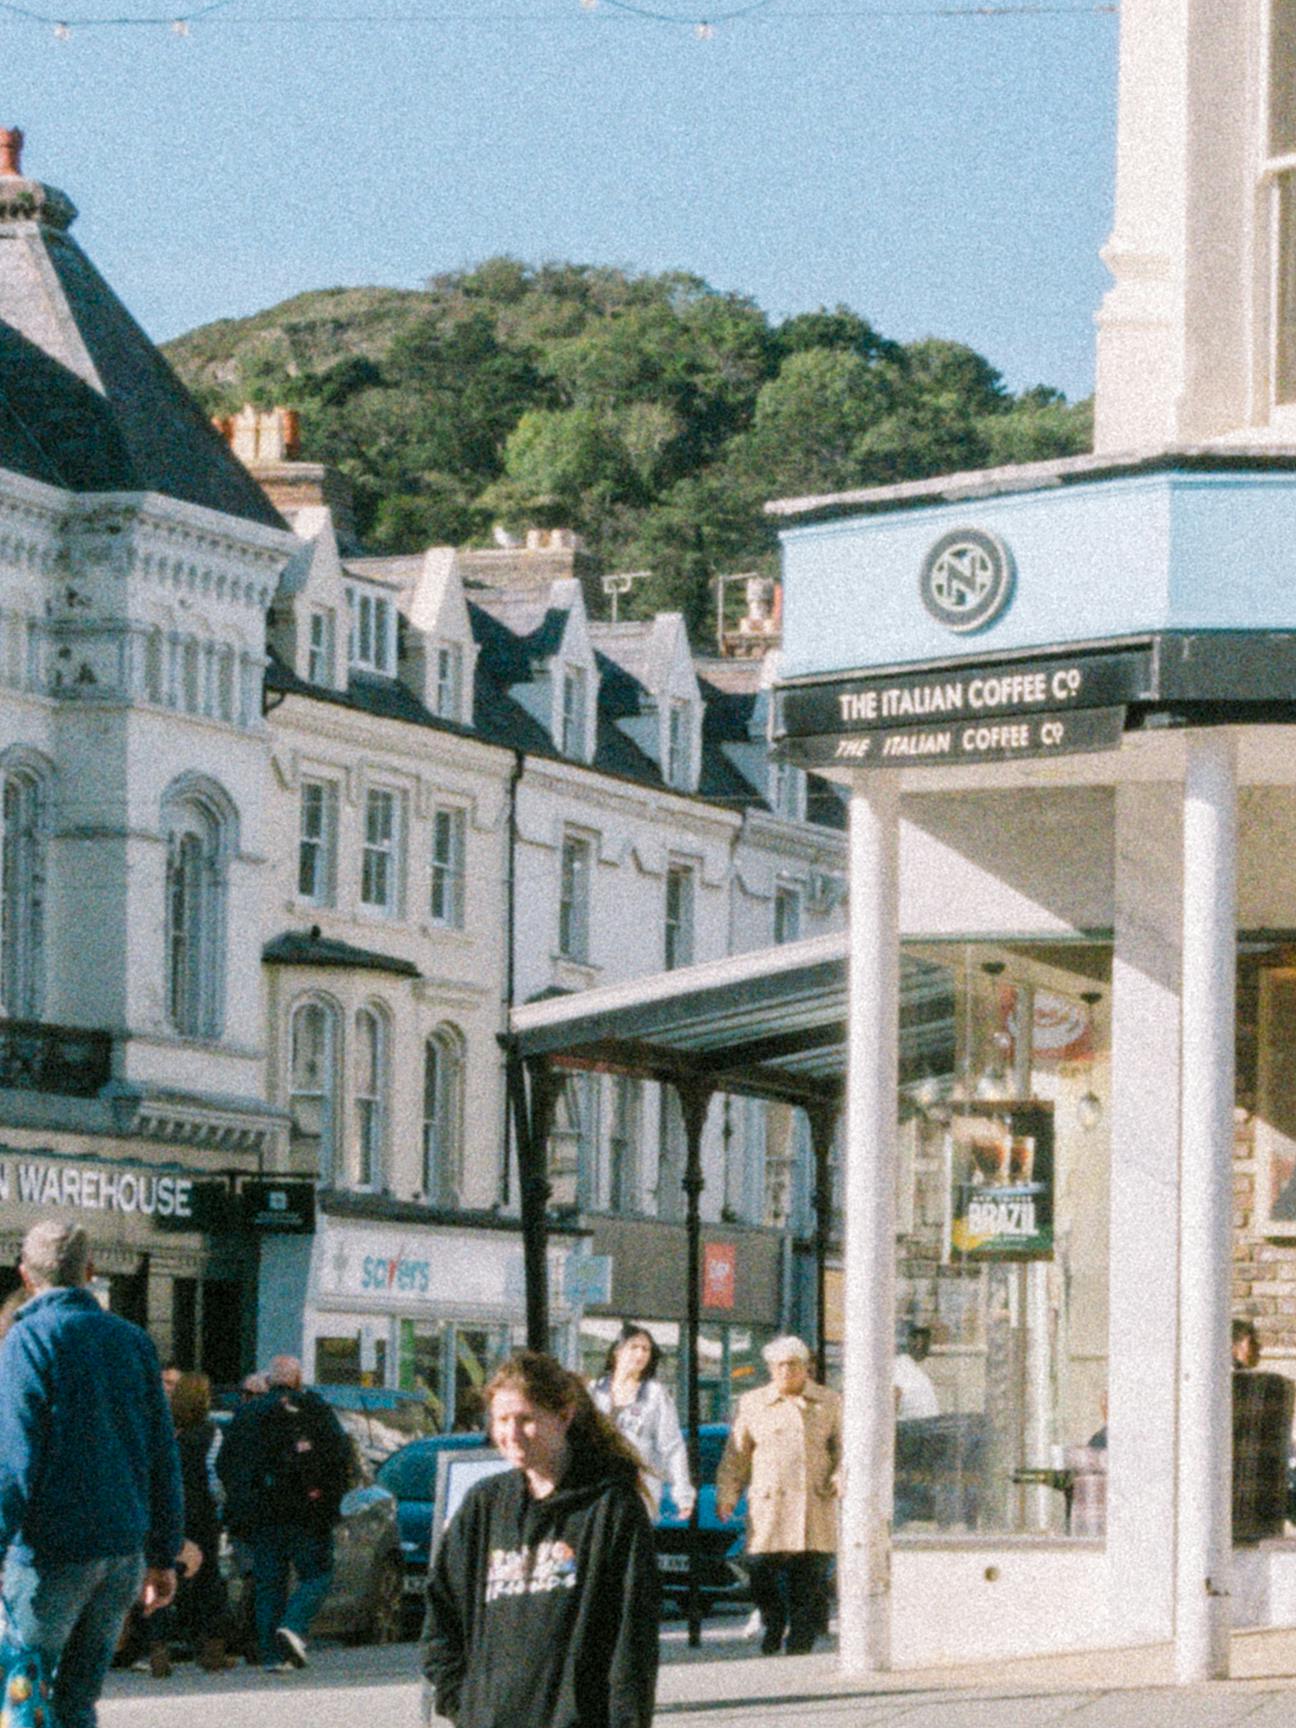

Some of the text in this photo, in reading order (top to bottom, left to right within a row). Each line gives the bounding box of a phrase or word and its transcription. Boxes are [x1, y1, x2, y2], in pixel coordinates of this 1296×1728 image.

[839, 691, 878, 722] THE
[881, 682, 963, 717] ITALIAN
[967, 673, 1047, 709] COFFEE
[834, 739, 871, 758] THE
[882, 732, 951, 756] ITALIAN
[962, 724, 1030, 751] COFFEE
[19, 1163, 193, 1217] WAREHOUSE
[968, 1201, 1040, 1237] BRAZIL
